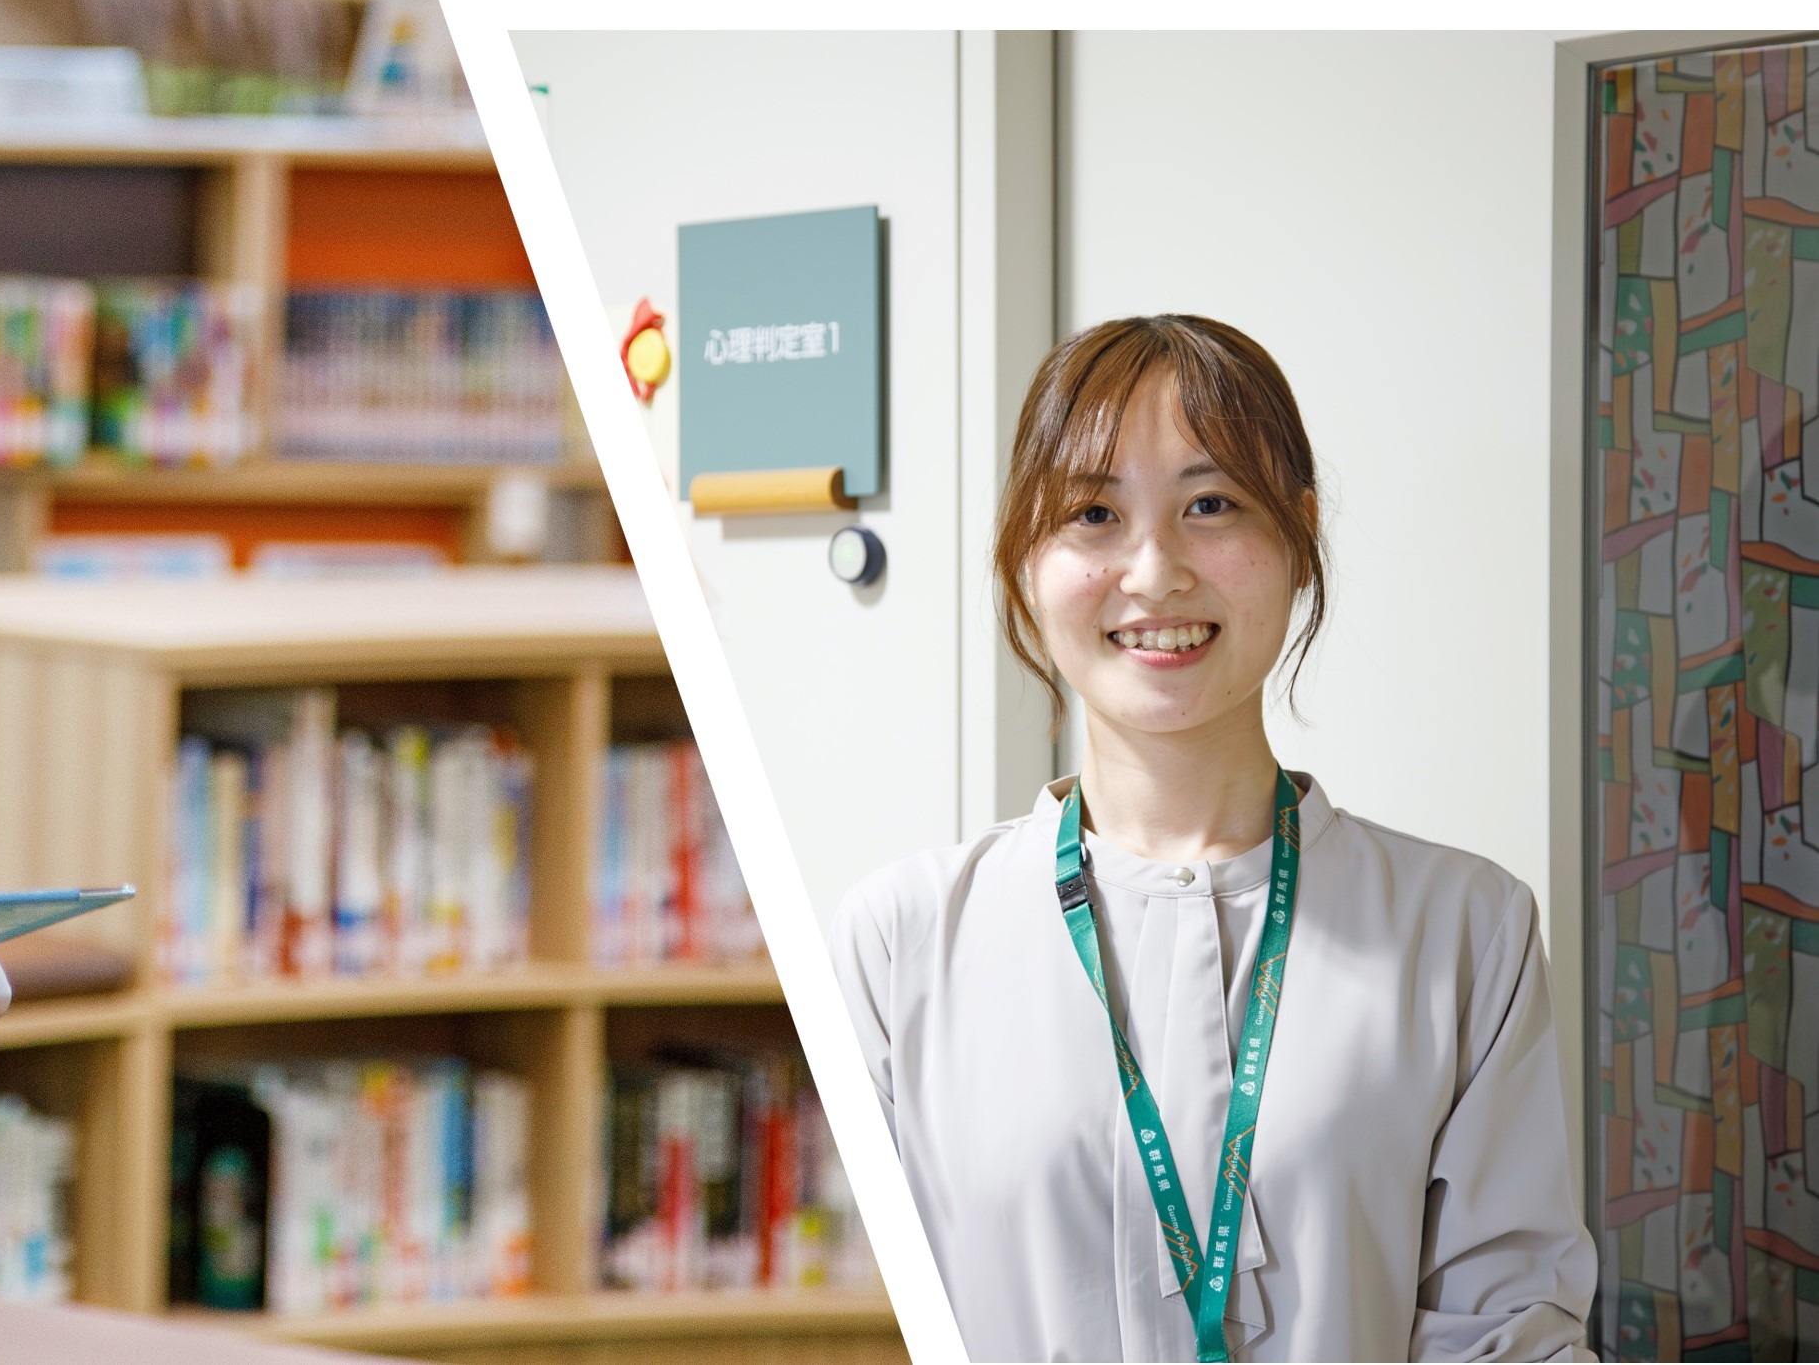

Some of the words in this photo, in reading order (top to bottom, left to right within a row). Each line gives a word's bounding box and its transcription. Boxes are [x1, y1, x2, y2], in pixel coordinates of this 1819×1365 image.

[704, 321, 840, 365] 心理判定室1
[1255, 999, 1266, 1026] Gunma
[1148, 1148, 1171, 1192] 群馬県
[1228, 1135, 1242, 1178] Prefecture
[1223, 1181, 1235, 1211] Gunma
[1167, 1204, 1180, 1234] Gunma
[1177, 1236, 1195, 1281] Prefecture
[1213, 1225, 1230, 1268] 群馬県
